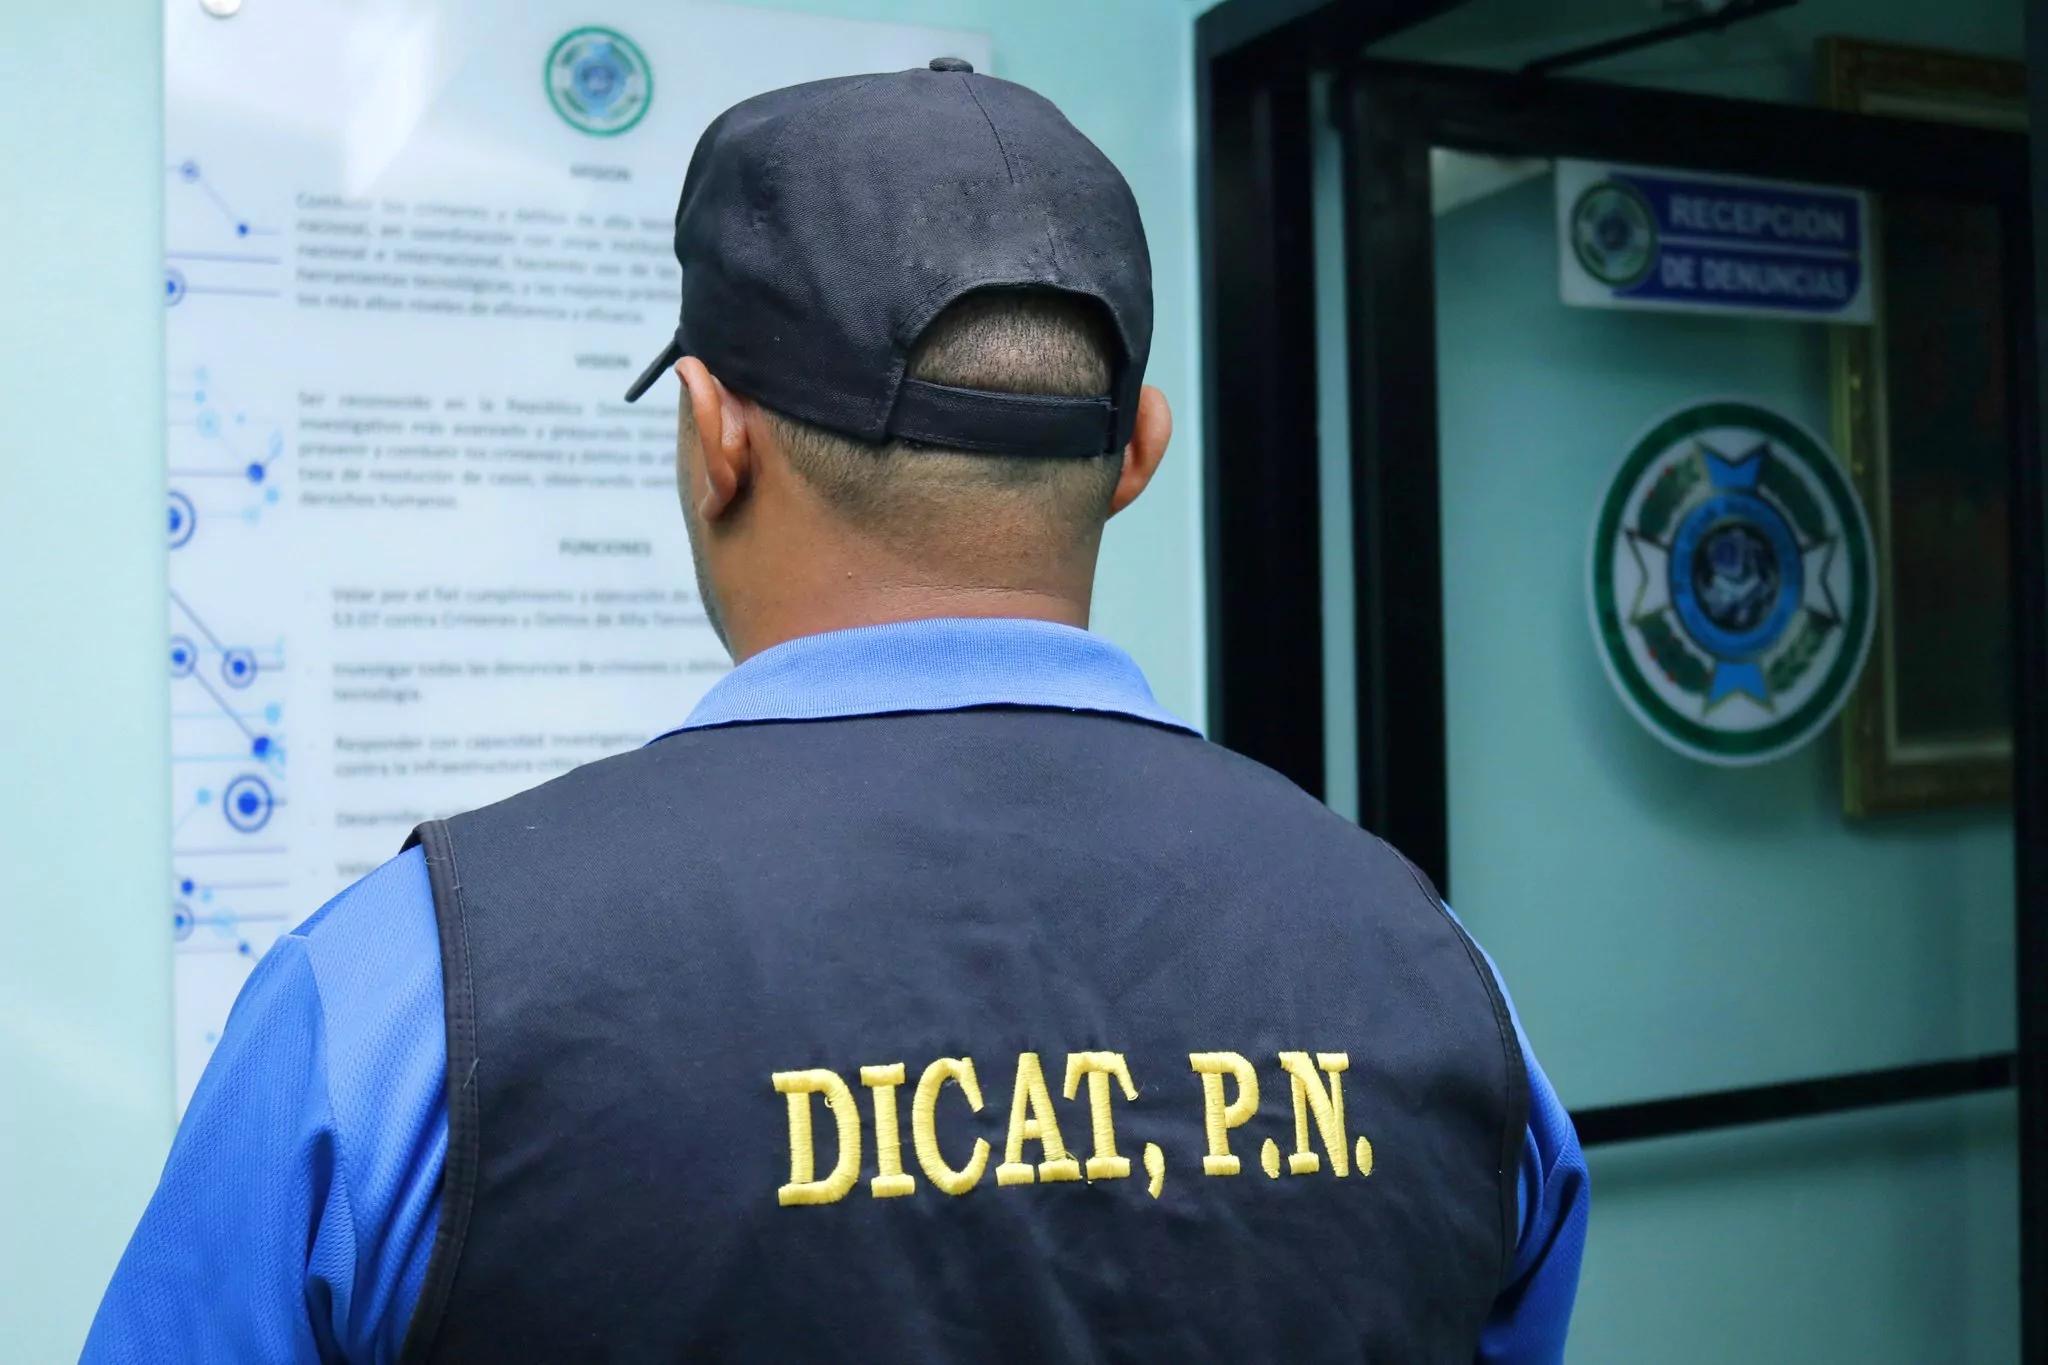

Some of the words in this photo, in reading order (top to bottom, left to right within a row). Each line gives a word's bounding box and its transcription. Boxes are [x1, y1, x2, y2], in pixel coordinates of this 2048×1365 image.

[1661, 256, 1695, 289] DE
[1702, 259, 1847, 299] DENUNCIAS
[771, 1051, 1165, 1207] DICAT,
[1189, 1051, 1373, 1179] P.N.
